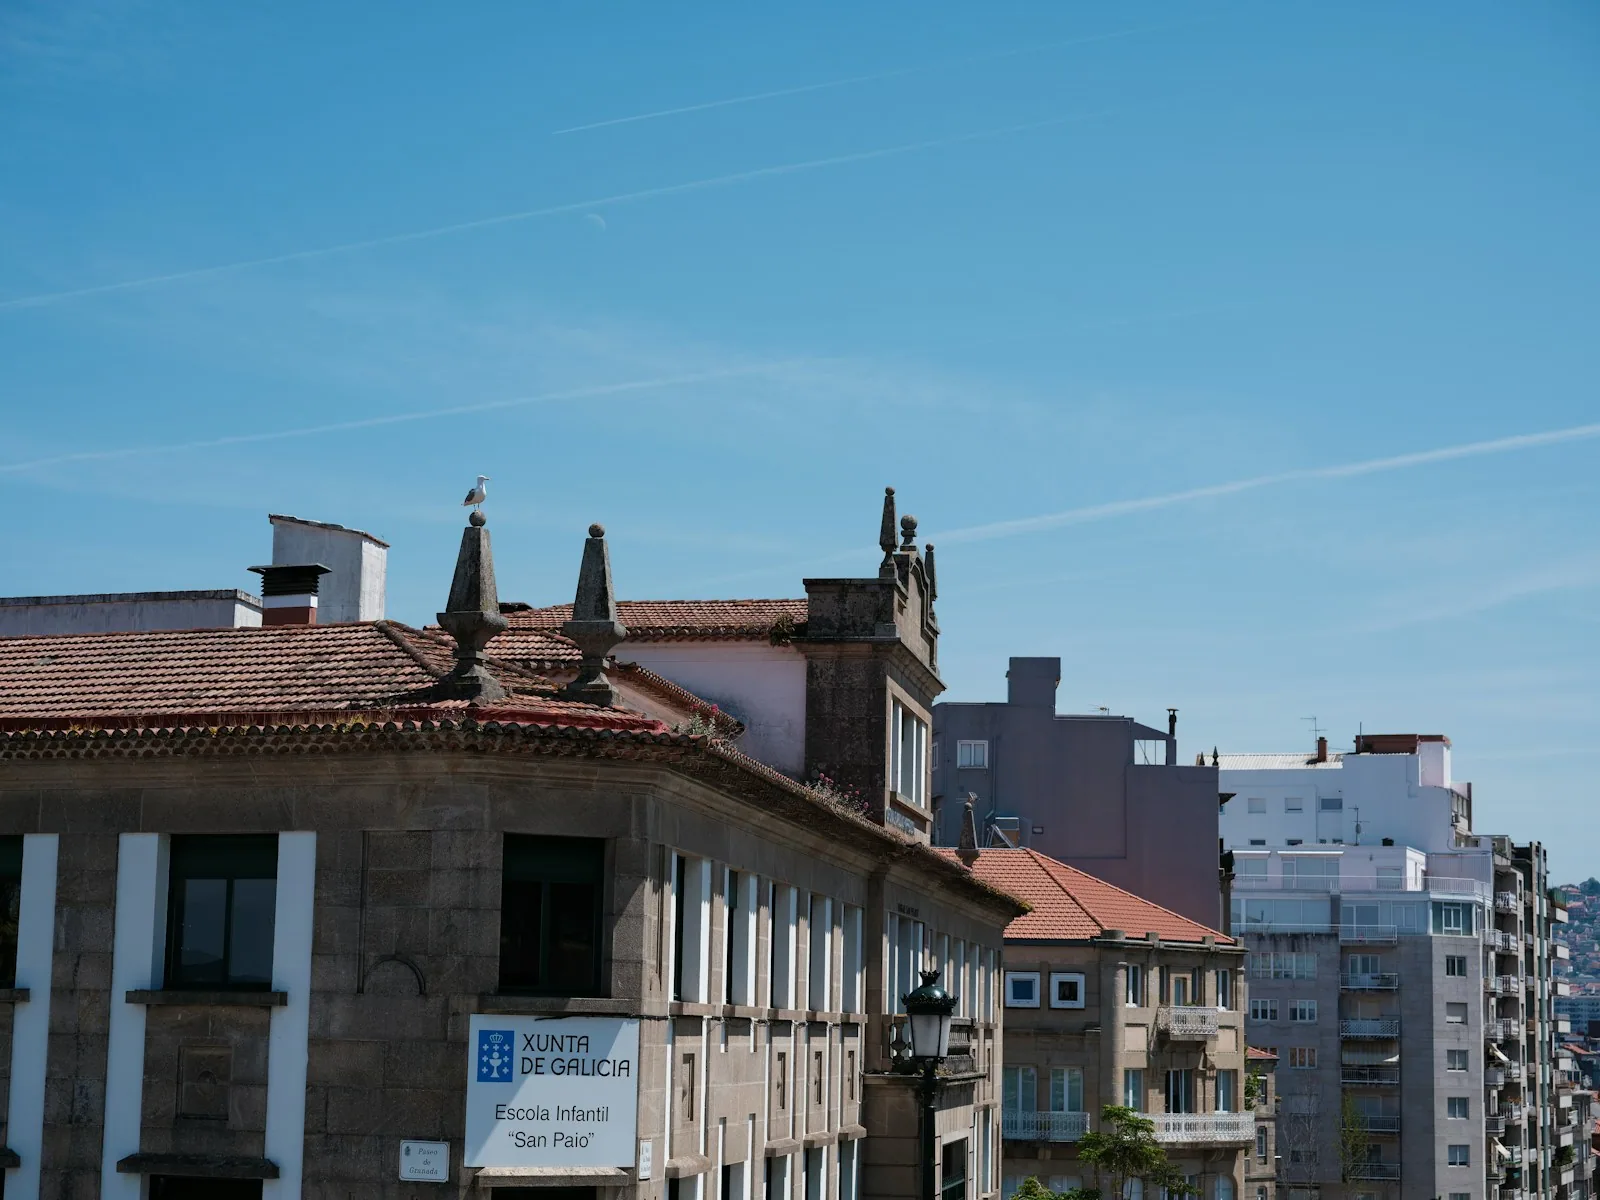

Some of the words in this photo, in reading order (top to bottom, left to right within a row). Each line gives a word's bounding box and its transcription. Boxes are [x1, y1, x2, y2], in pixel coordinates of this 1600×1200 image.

[522, 1033, 589, 1053] XUNTA
[520, 1057, 545, 1075] DE
[551, 1057, 630, 1077] GALICIA
[495, 1104, 550, 1121] Escola
[556, 1105, 609, 1122] Infantil
[508, 1130, 546, 1148] “San
[553, 1131, 595, 1148] Paio”
[418, 1147, 438, 1155] Paseo
[409, 1166, 438, 1175] Granada
[423, 1158, 431, 1166] de
